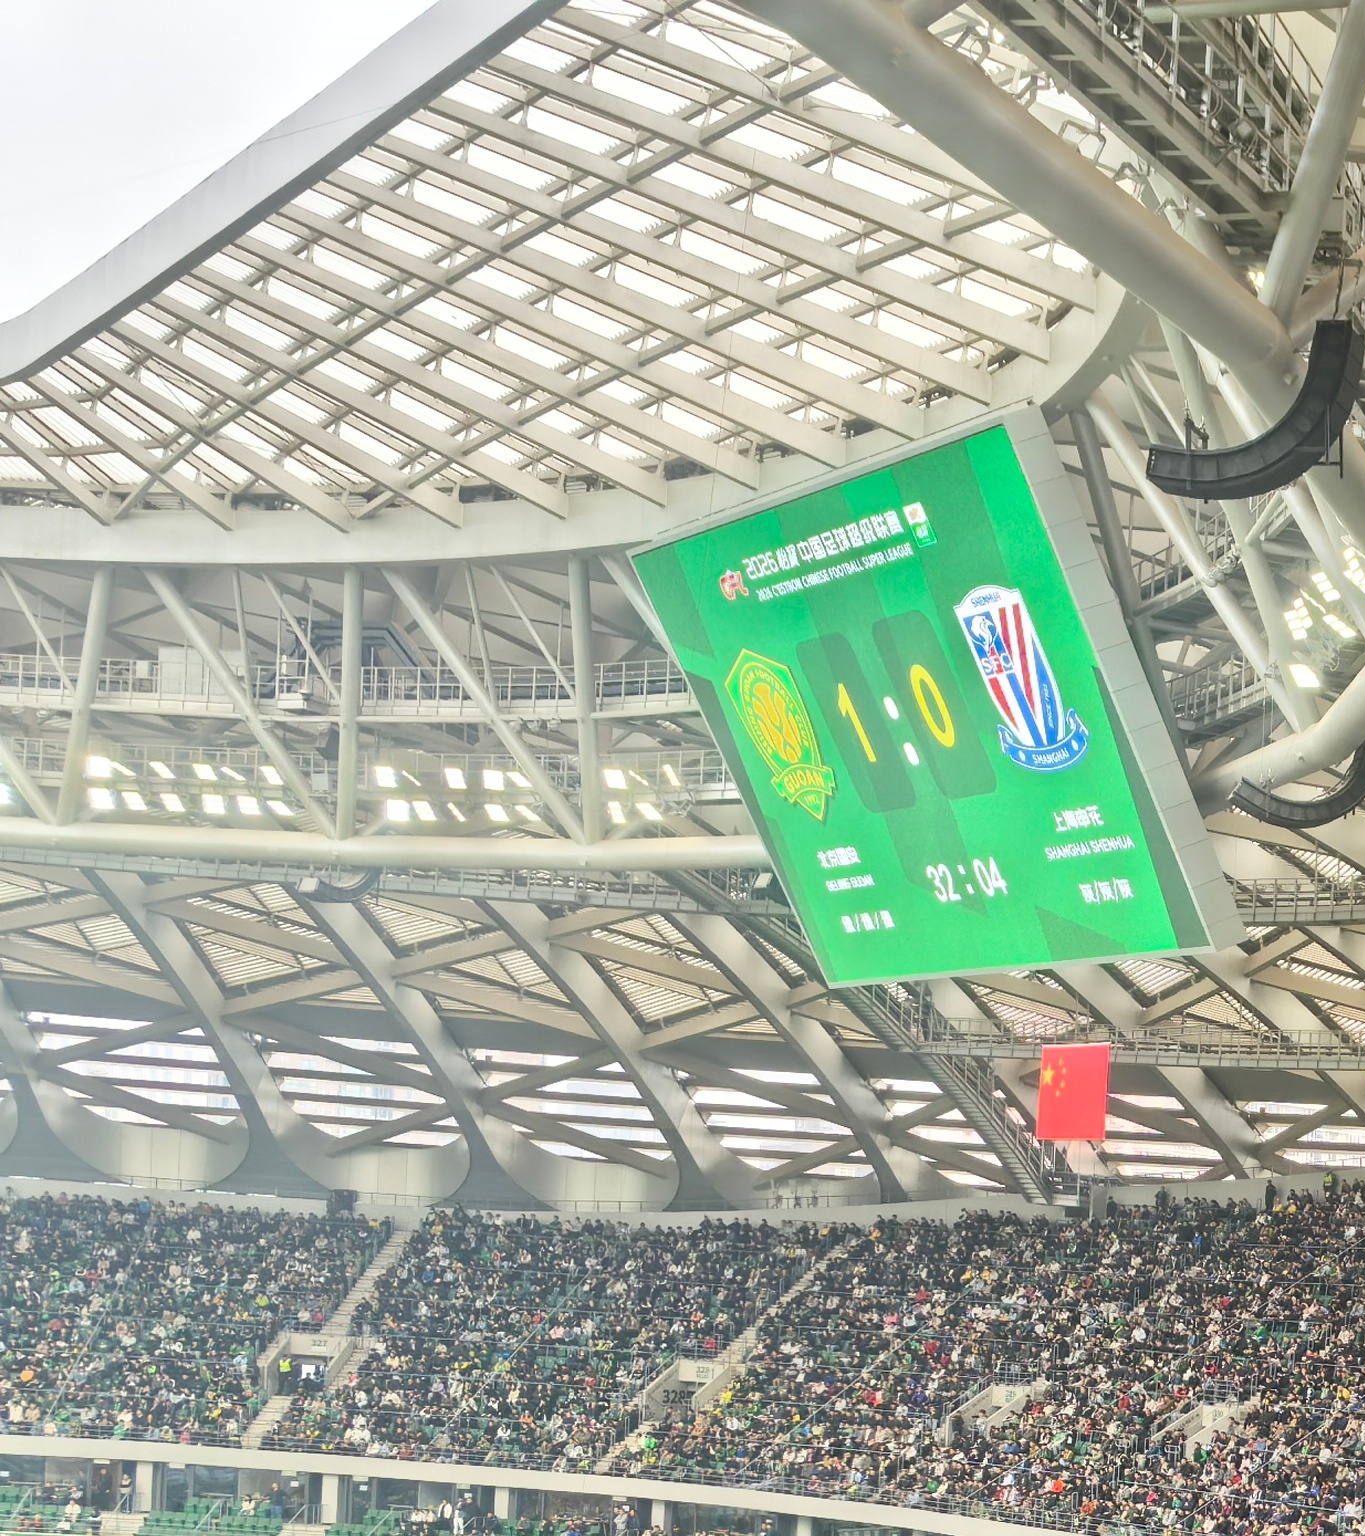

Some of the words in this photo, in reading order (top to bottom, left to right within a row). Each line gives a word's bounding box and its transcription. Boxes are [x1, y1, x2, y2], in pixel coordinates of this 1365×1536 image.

[802, 568, 829, 589] CHINESE
[828, 557, 863, 579] FOOTBALL
[862, 550, 887, 570] SUPER
[885, 542, 914, 563] LEAGUE
[981, 653, 1013, 675] SFC
[1032, 748, 1070, 765] SHANGHAI
[784, 769, 825, 794] GUOAN
[1044, 841, 1091, 862] SHANGHAI
[1090, 835, 1136, 856] SHENHUA
[926, 856, 1010, 904] 32:04
